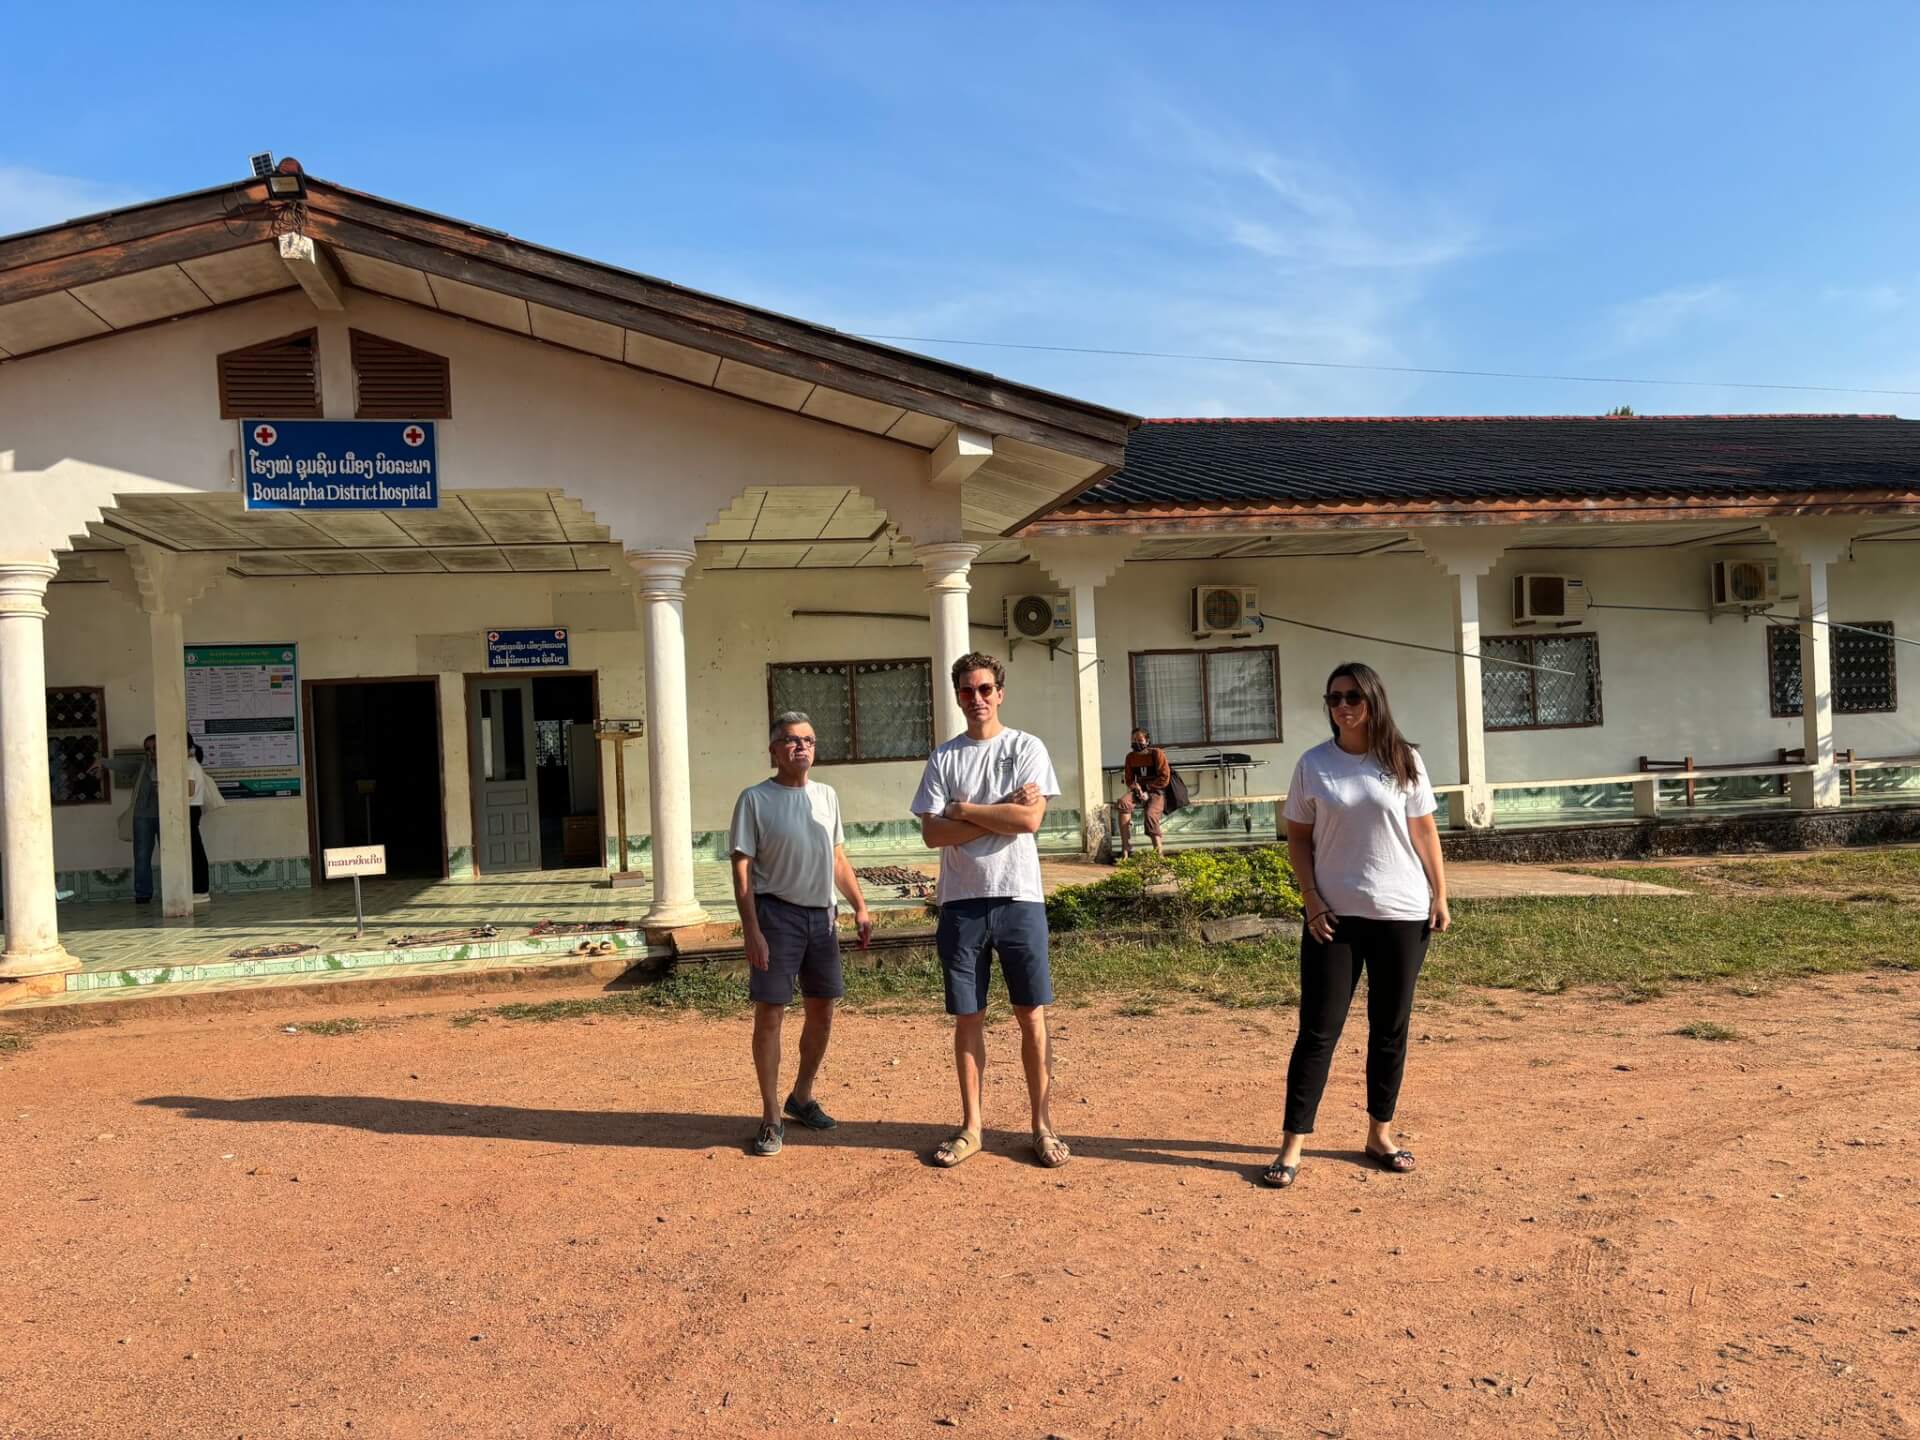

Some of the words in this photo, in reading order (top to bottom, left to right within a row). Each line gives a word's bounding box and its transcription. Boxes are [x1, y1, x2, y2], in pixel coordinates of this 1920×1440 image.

[339, 451, 374, 479] ເມືອງ
[375, 452, 431, 474] ບົວລະພາ
[252, 481, 325, 506] Boualapha
[326, 484, 377, 501] District
[379, 481, 432, 506] hospital
[530, 656, 540, 664] 24
